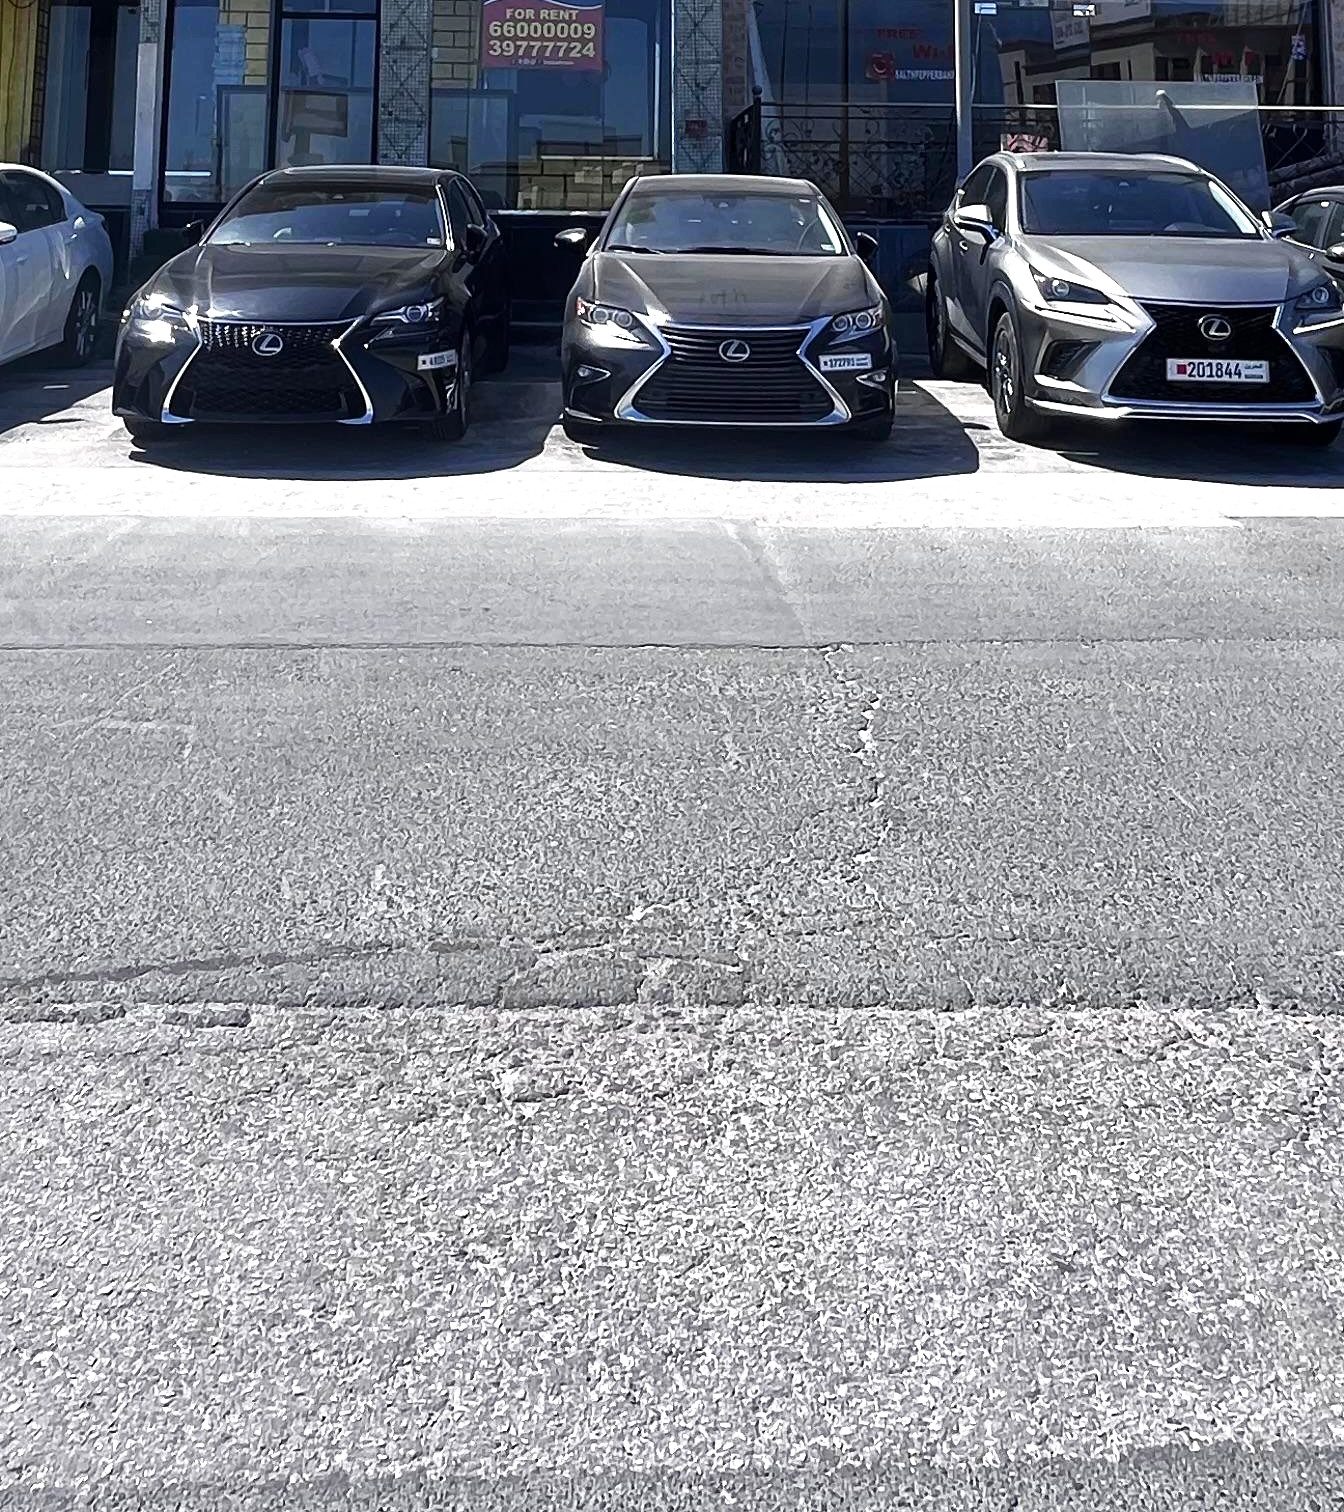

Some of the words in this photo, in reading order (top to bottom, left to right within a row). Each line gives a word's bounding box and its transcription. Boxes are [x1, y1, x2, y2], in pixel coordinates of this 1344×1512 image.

[505, 8, 535, 20] FOR
[540, 9, 579, 21] RENT
[489, 21, 595, 39] 66000009
[488, 40, 595, 58] 39777724
[1187, 361, 1242, 379] 201844
